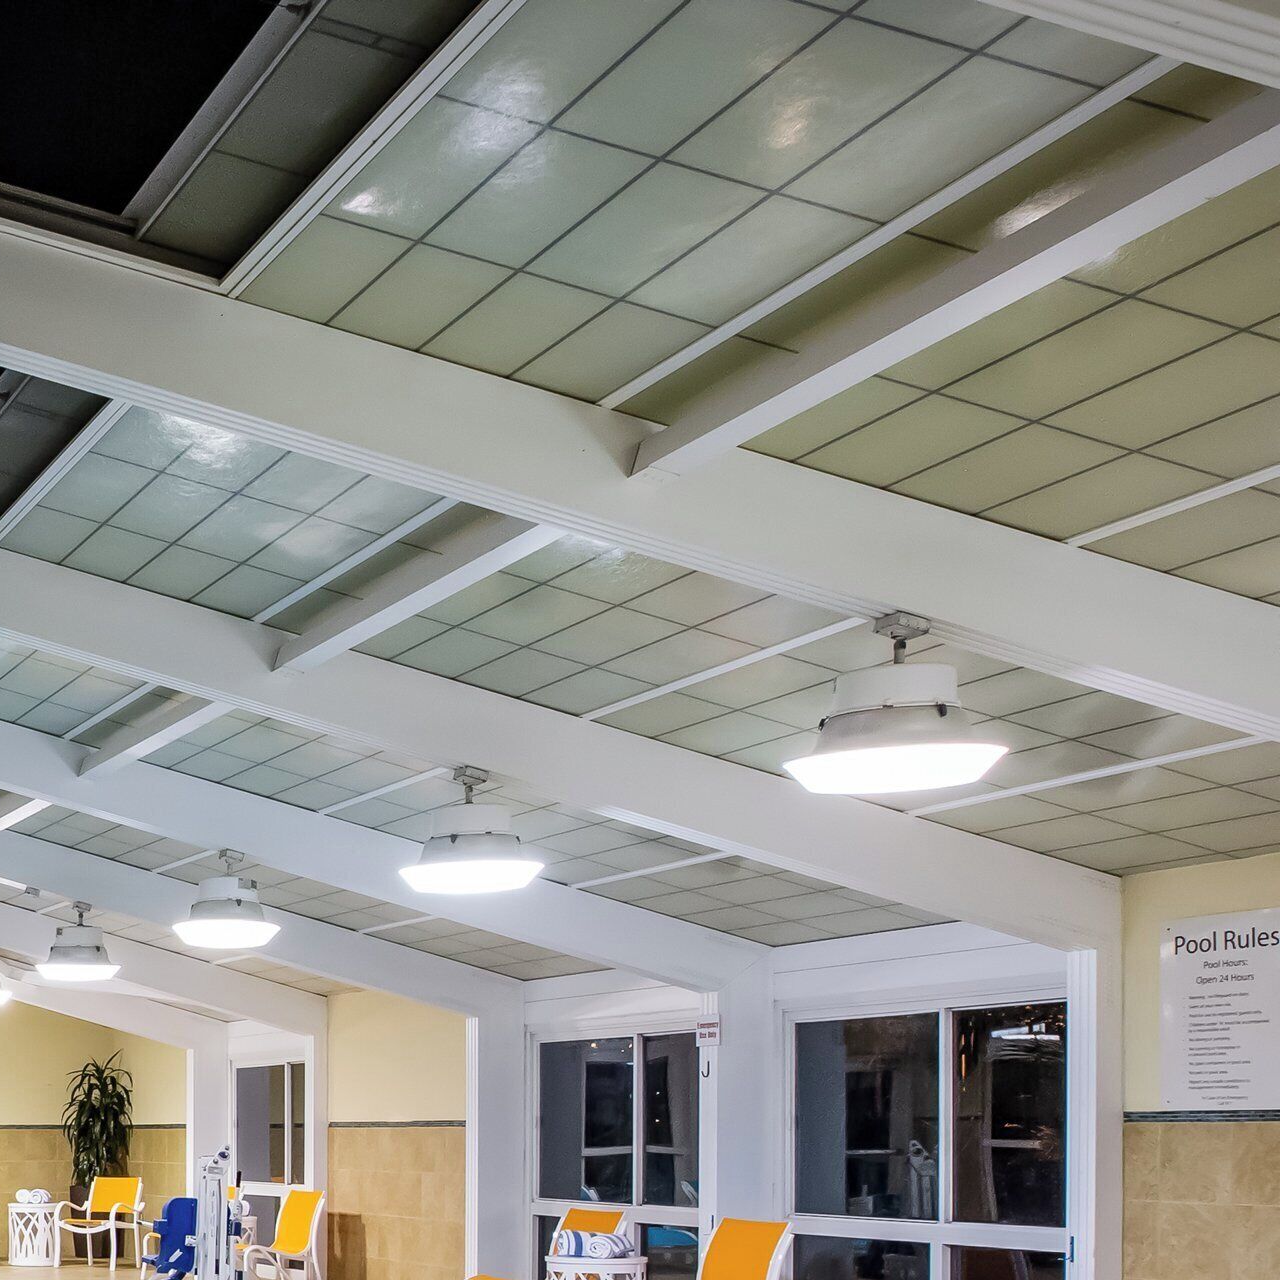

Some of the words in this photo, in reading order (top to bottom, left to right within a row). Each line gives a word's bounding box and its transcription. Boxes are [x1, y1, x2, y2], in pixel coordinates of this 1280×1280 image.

[1175, 931, 1217, 955] Pool
[1224, 927, 1280, 950] Rules
[1203, 960, 1221, 969] Pool
[1195, 976, 1218, 985] Open
[1219, 974, 1229, 983] 24
[1230, 974, 1255, 983] Hours
